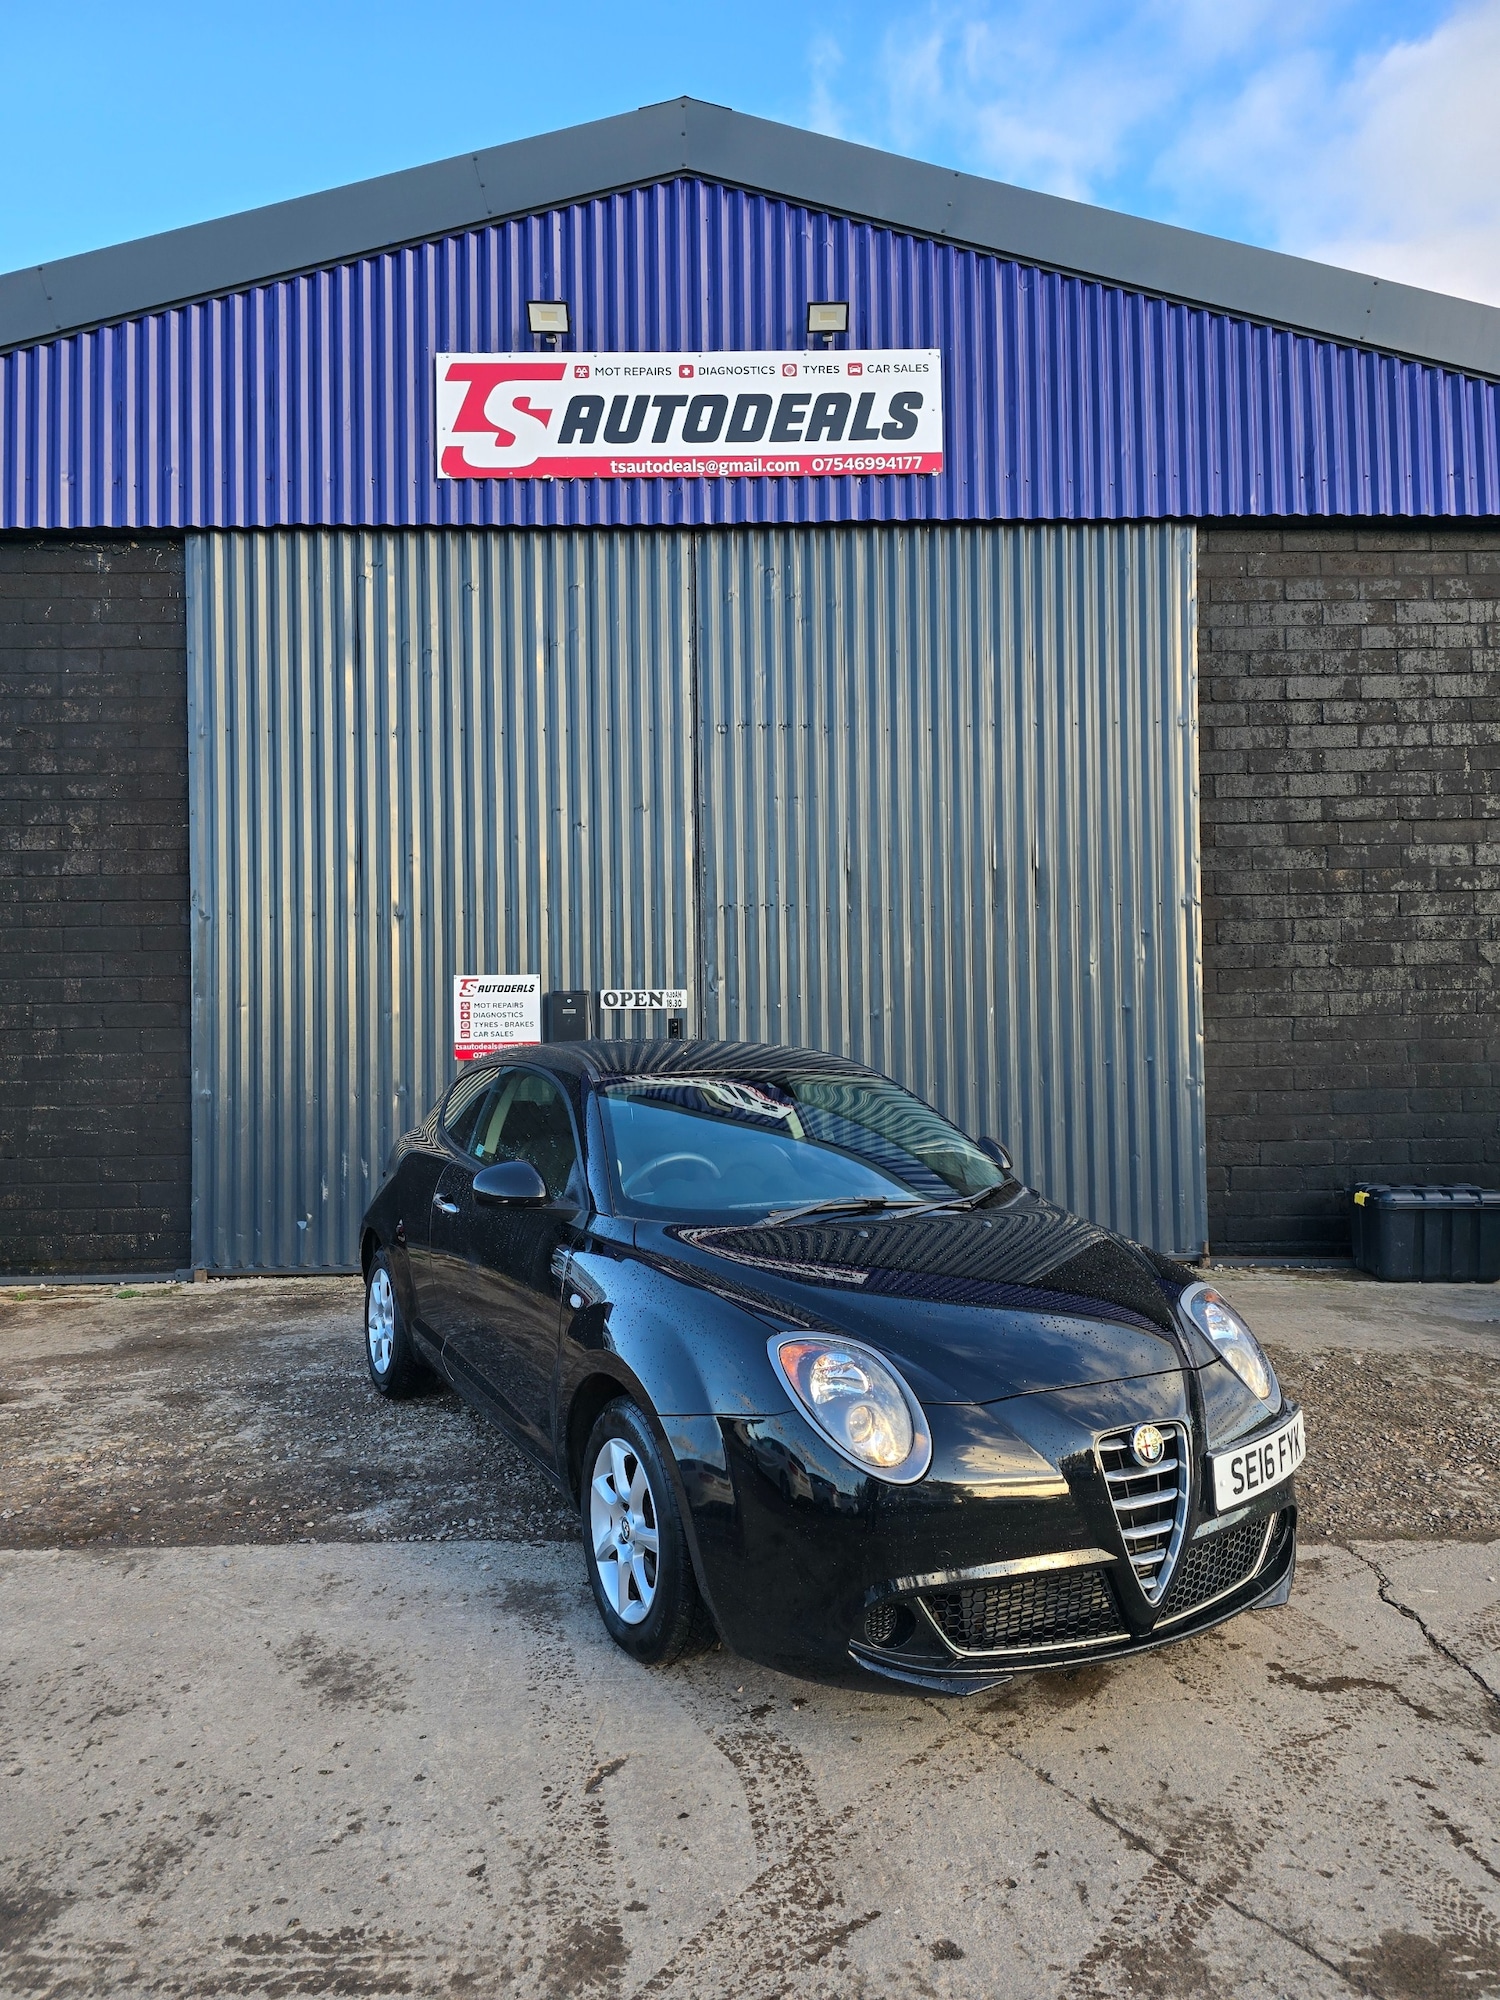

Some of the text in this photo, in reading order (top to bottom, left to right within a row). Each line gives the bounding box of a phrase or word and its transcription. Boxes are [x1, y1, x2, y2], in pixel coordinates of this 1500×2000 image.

[595, 366, 672, 377] MOT REPAIRS
[698, 365, 776, 376] DIAGNOSTICS
[803, 364, 840, 375] TYRES
[867, 363, 930, 374] CAR SALES
[441, 363, 924, 477] TS AUTODEALS
[610, 456, 923, 475] tsautodeals@gmail.com 07546994177
[477, 984, 535, 993] AUTODEALS
[603, 991, 664, 1007] OPEN
[1231, 1422, 1301, 1495] SE16 FYK
